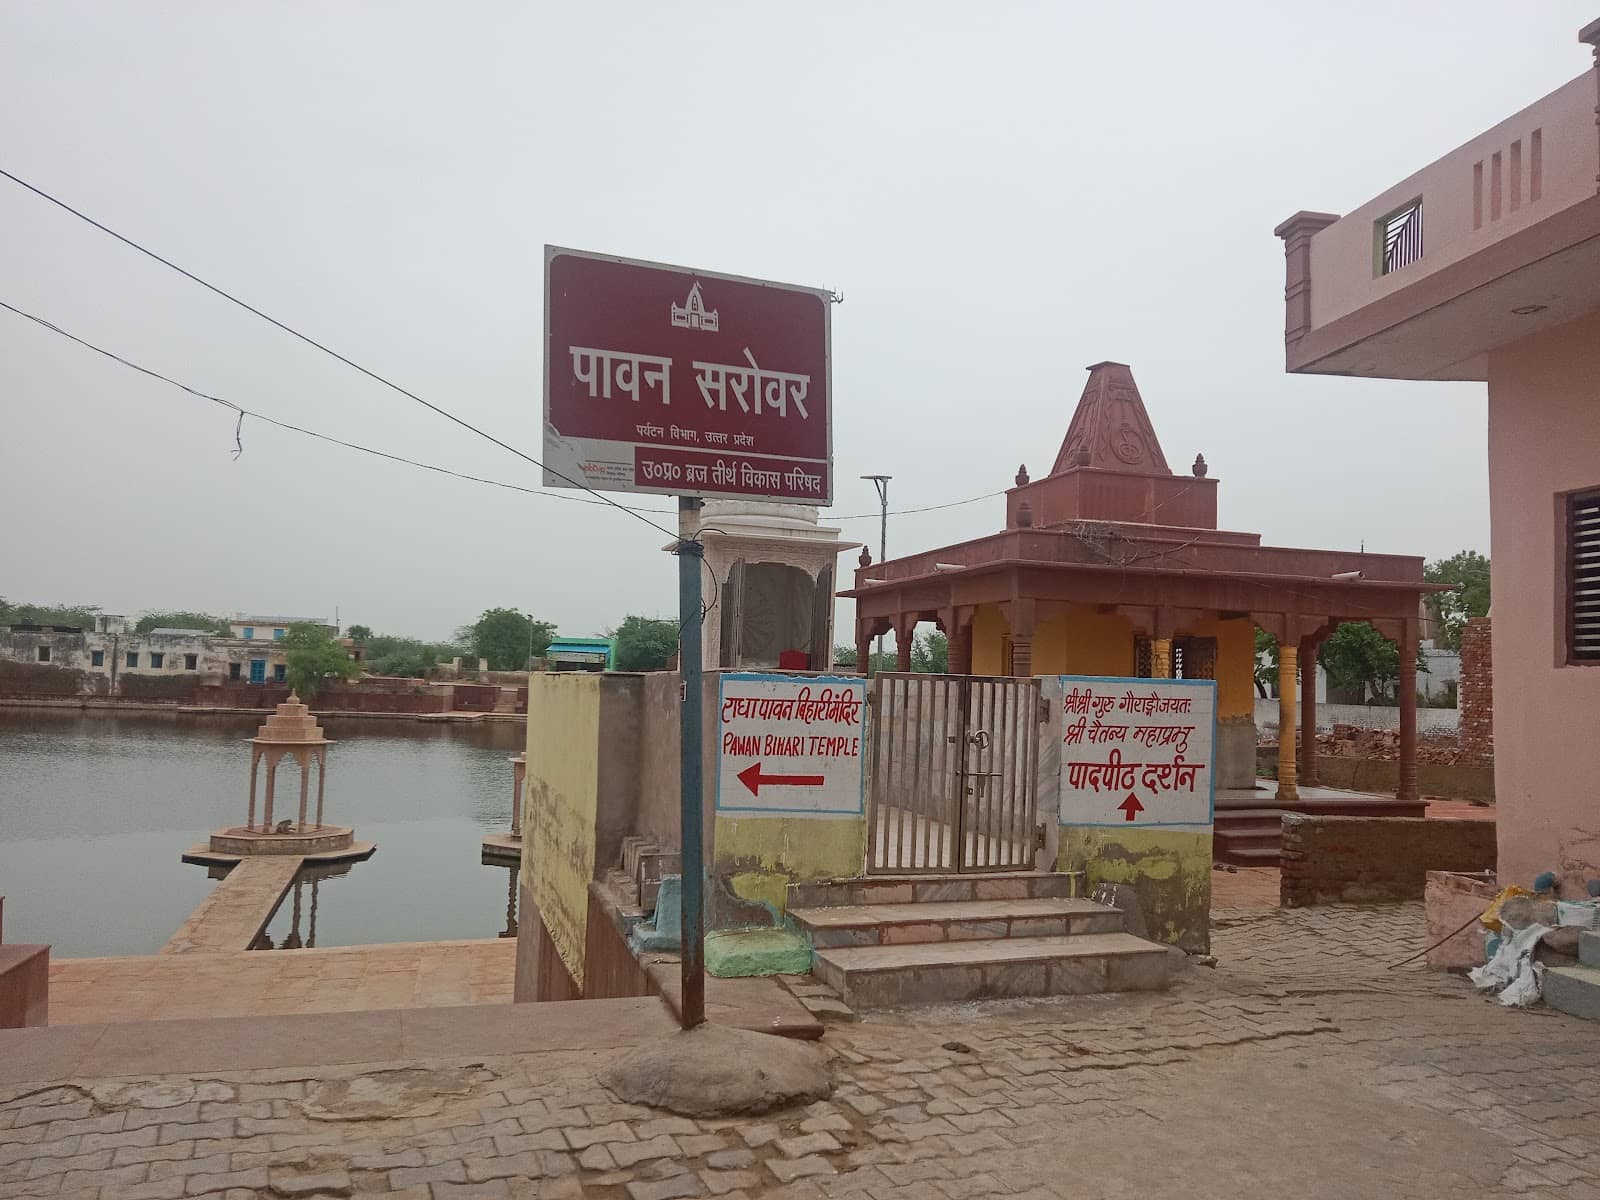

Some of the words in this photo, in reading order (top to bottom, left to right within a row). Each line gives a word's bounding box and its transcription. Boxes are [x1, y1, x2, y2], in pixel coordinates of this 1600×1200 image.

[569, 345, 673, 405] पावन
[692, 347, 810, 420] सरोवर
[636, 422, 664, 438] पर्यटन
[670, 424, 700, 443] विभाग,
[705, 431, 728, 444] उत्तर
[734, 432, 754, 447] प्रदेश
[685, 464, 708, 484] ब्रज
[712, 459, 737, 486] तीर्थ
[741, 461, 781, 490] विकास
[784, 466, 821, 493] परिषद
[1092, 696, 1116, 719] गुरु
[723, 731, 761, 757] PAWAN
[763, 733, 806, 757] BIHARI
[808, 735, 859, 757] TEMPLE
[1063, 716, 1086, 746] श्री
[1088, 719, 1130, 745] चैतन्य
[1067, 748, 1143, 793] पादपीठ
[1141, 754, 1206, 794] दर्शन
